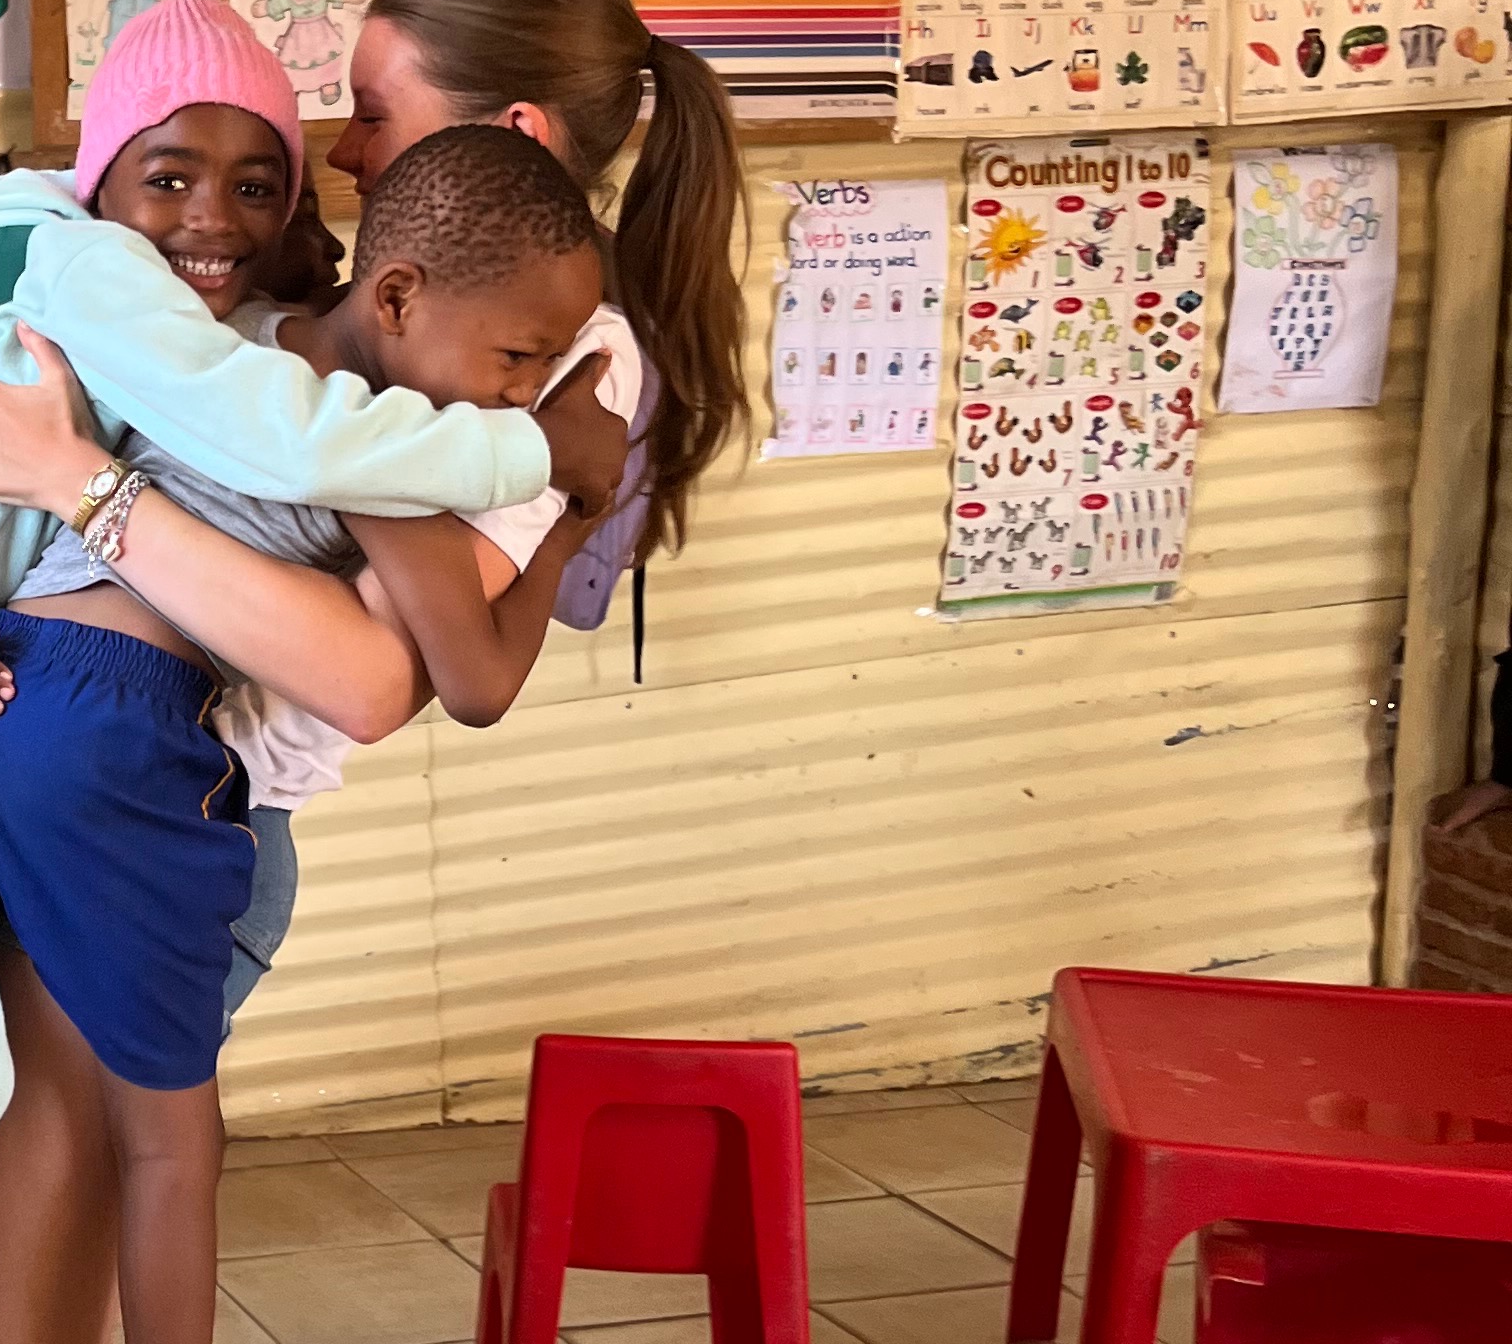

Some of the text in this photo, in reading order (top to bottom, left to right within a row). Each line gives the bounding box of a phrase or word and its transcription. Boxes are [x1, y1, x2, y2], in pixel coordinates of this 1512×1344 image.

[986, 155, 1121, 193] Counting
[1138, 159, 1162, 180] to
[1168, 152, 1192, 179] 10
[792, 178, 870, 205] Verbs
[804, 223, 932, 248] verb is a action
[823, 258, 839, 269] or
[845, 251, 881, 276] doing
[1195, 261, 1206, 279] 3
[1114, 266, 1124, 284] 2
[1109, 367, 1120, 385] 5
[1190, 361, 1200, 379] 6
[1062, 468, 1073, 486] 7
[1184, 459, 1194, 477] 8
[1159, 553, 1180, 570] 10
[1051, 564, 1062, 581] 9
